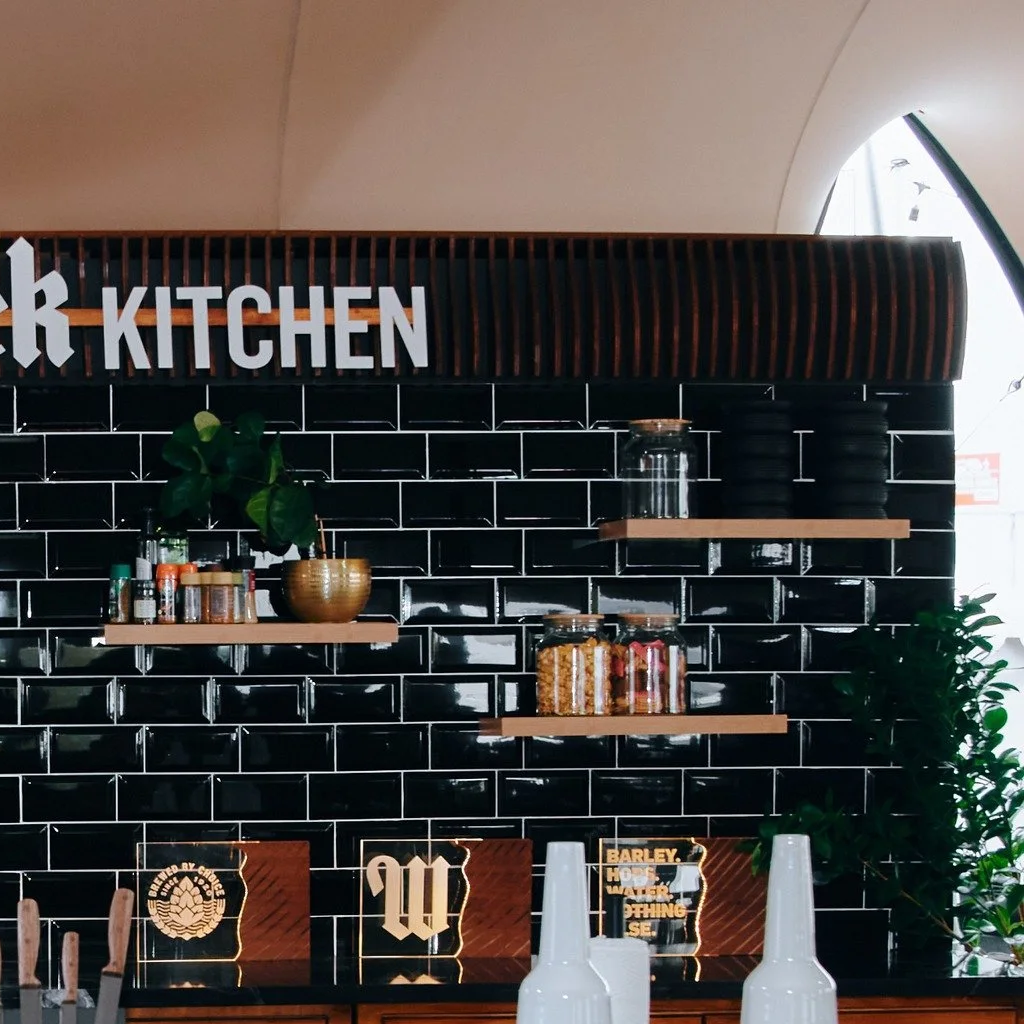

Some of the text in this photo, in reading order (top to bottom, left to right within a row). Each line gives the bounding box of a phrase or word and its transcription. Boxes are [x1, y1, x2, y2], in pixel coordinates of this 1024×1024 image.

[102, 284, 428, 370] KITCHEN
[606, 848, 681, 863] BARLEY.
[148, 862, 226, 898] BREWED BY CHOICE
[606, 884, 674, 899] WATER.
[623, 903, 687, 918] OTHING
